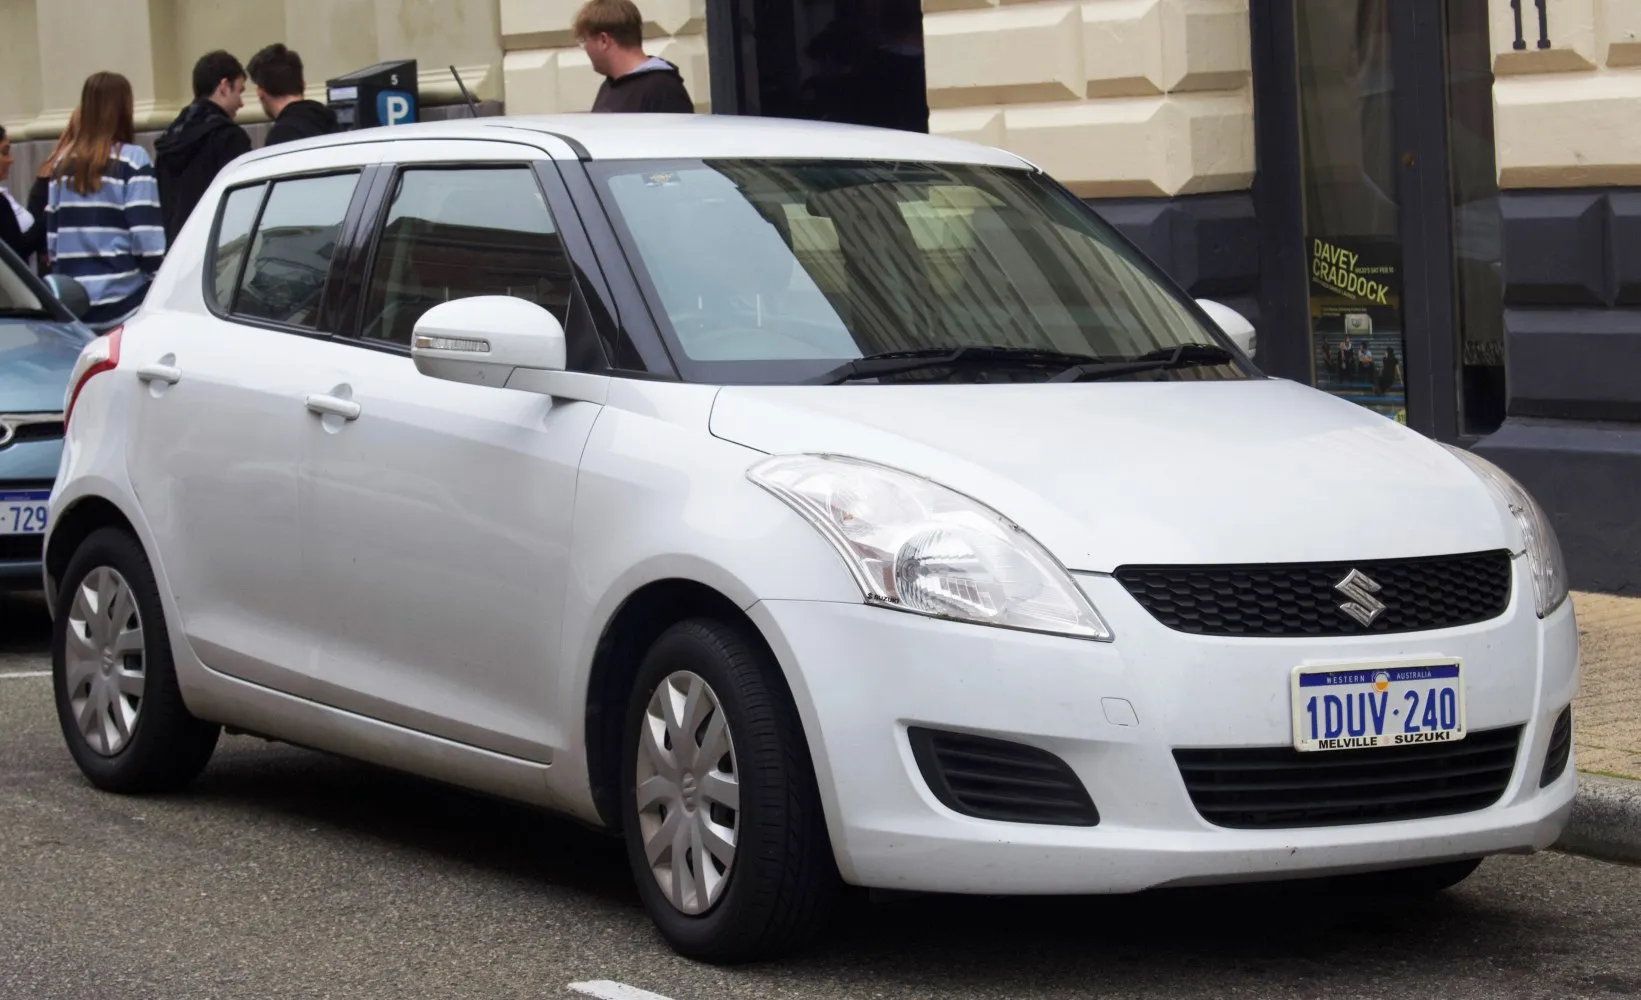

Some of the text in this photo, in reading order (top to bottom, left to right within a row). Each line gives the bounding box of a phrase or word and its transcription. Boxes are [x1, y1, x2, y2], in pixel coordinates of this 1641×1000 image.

[387, 96, 409, 126] P
[1314, 238, 1358, 271] DAVEY
[1312, 258, 1388, 304] CRADDOCK
[1327, 671, 1432, 684] WESTERN AUSTRALIA
[1318, 731, 1450, 749] MELVILLE SUZUKI
